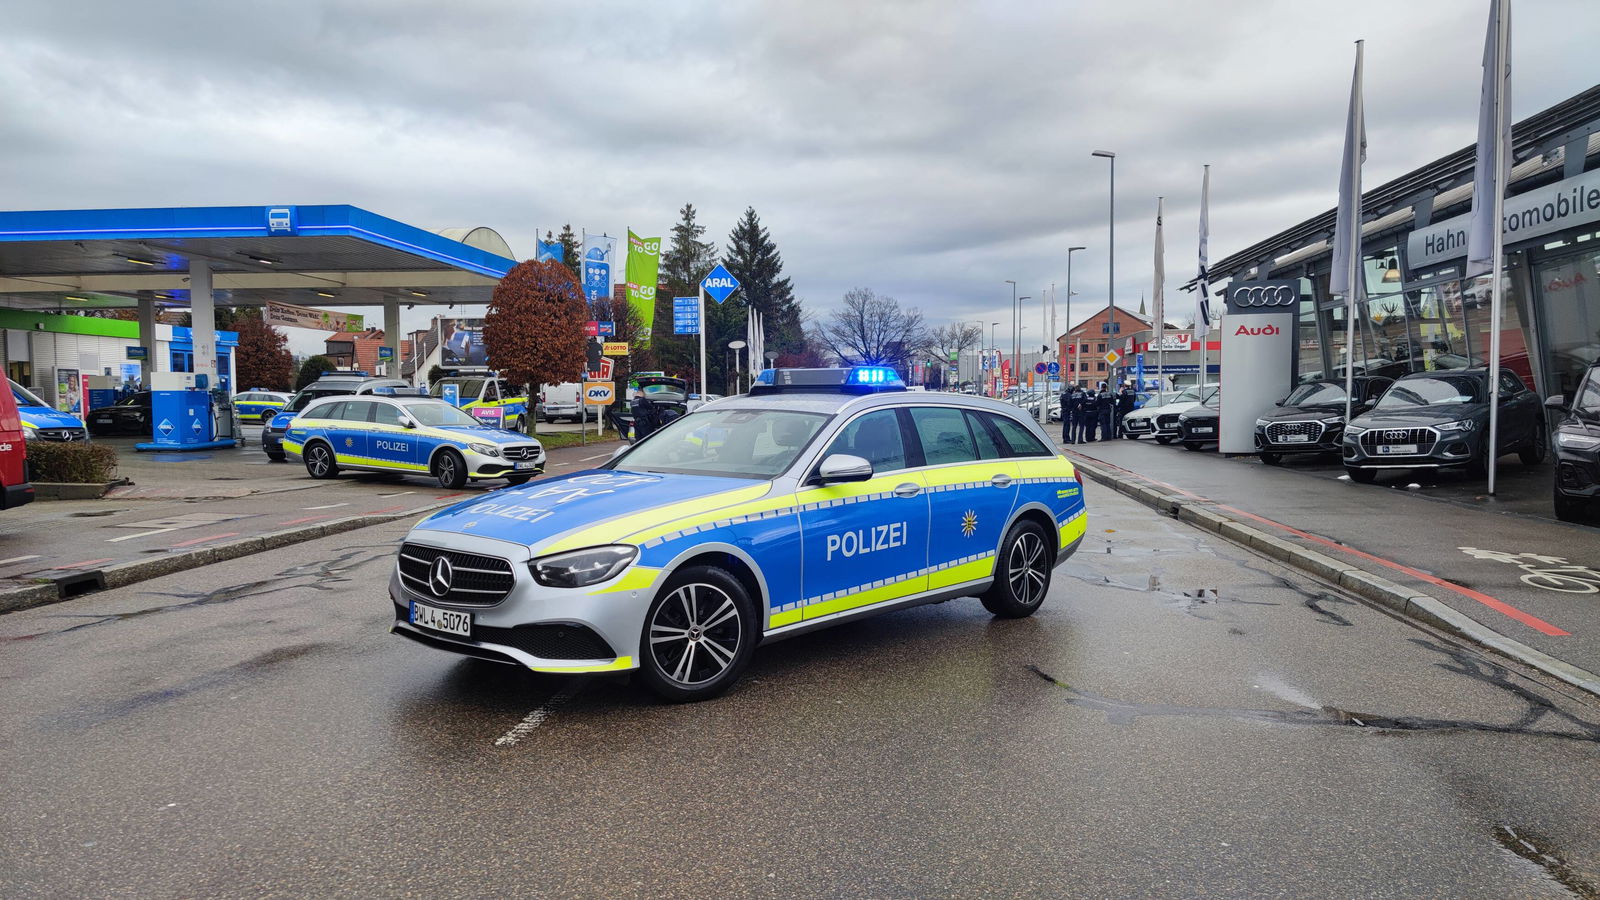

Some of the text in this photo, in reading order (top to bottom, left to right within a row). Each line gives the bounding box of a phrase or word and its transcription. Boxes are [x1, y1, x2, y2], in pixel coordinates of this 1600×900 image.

[633, 242, 659, 254] TO GO
[1425, 230, 1466, 256] Hahn
[705, 278, 734, 288] ARAL
[631, 285, 655, 298] TO GO
[1235, 325, 1280, 336] Audi
[588, 390, 610, 398] DKV
[376, 440, 409, 452] POLIZEI
[826, 521, 907, 562] POLIZEI
[414, 604, 469, 633] BWL 4 5076
